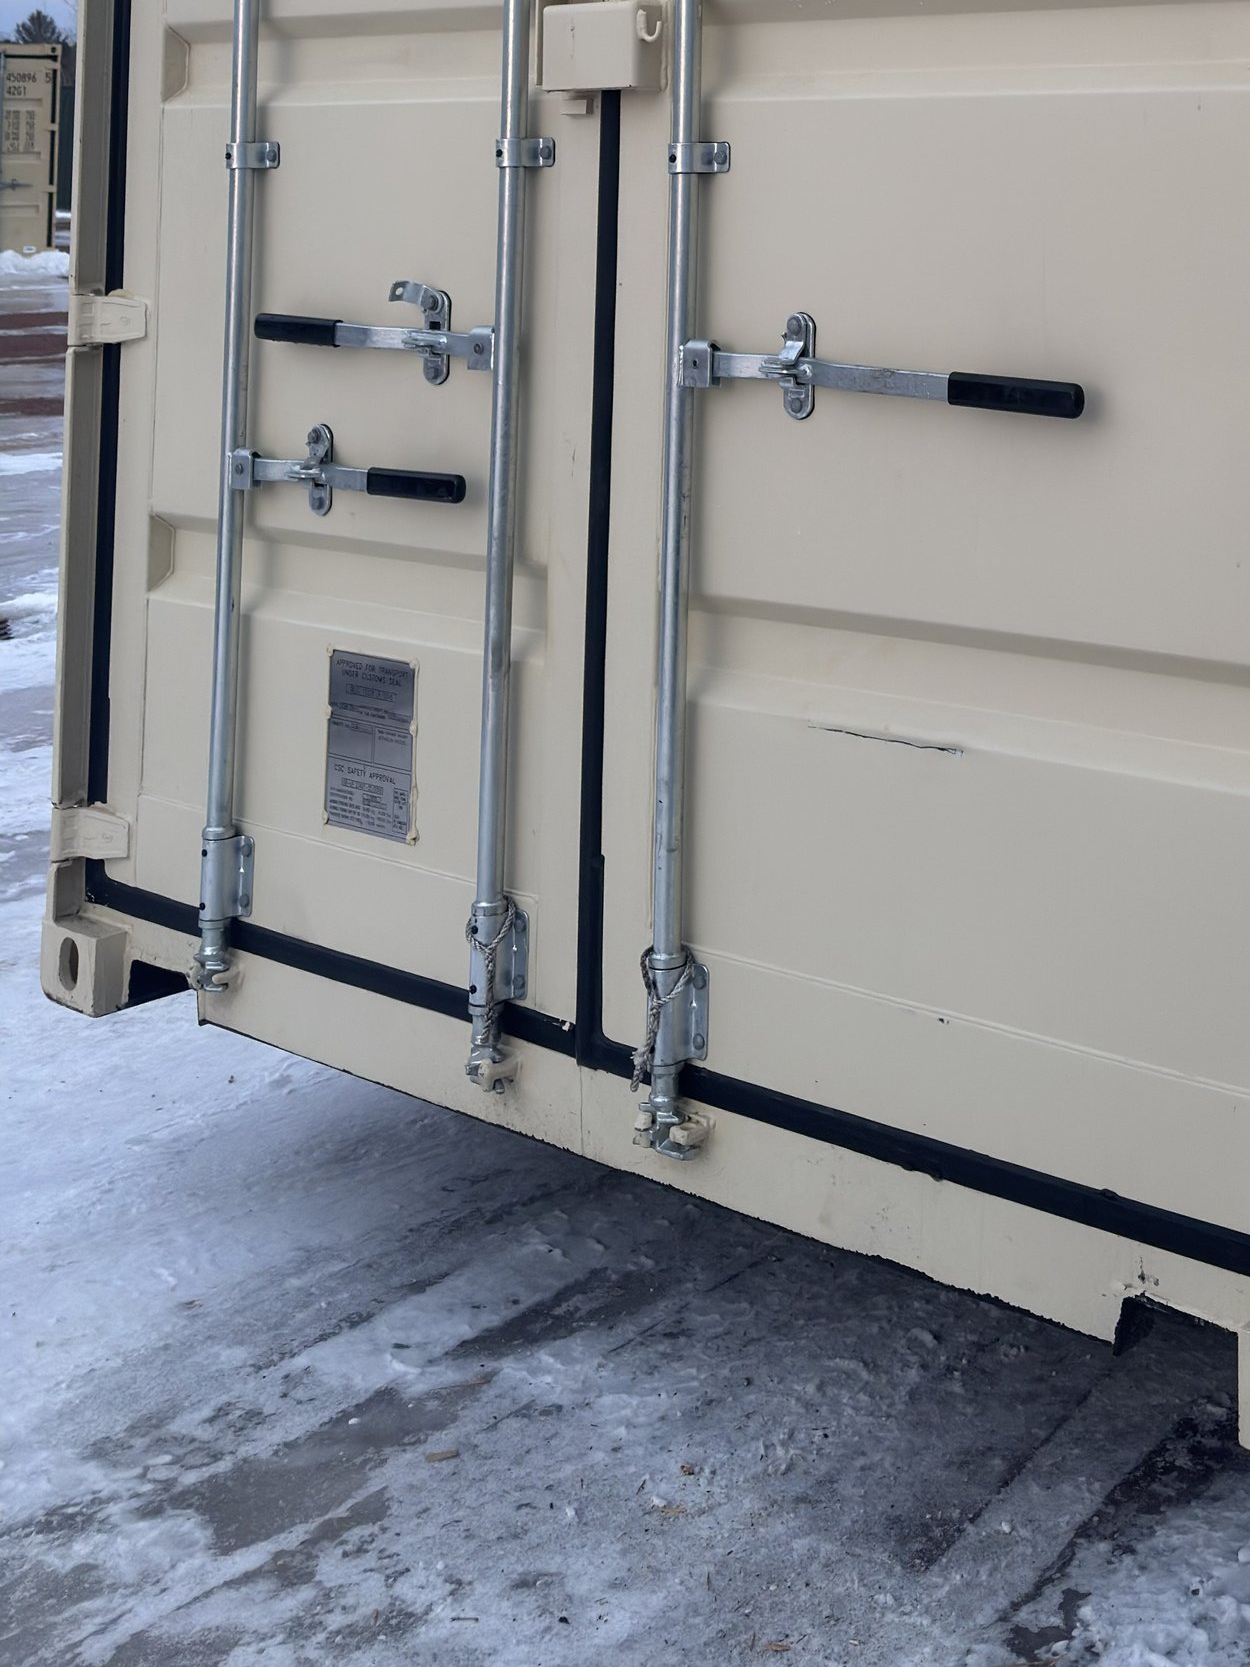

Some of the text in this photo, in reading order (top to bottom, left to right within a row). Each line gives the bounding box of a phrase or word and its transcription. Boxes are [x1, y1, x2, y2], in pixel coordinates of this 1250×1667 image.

[45, 72, 52, 84] 5
[6, 85, 27, 96] 42G1
[334, 763, 396, 785] CSC SAFETY APPROVAL
